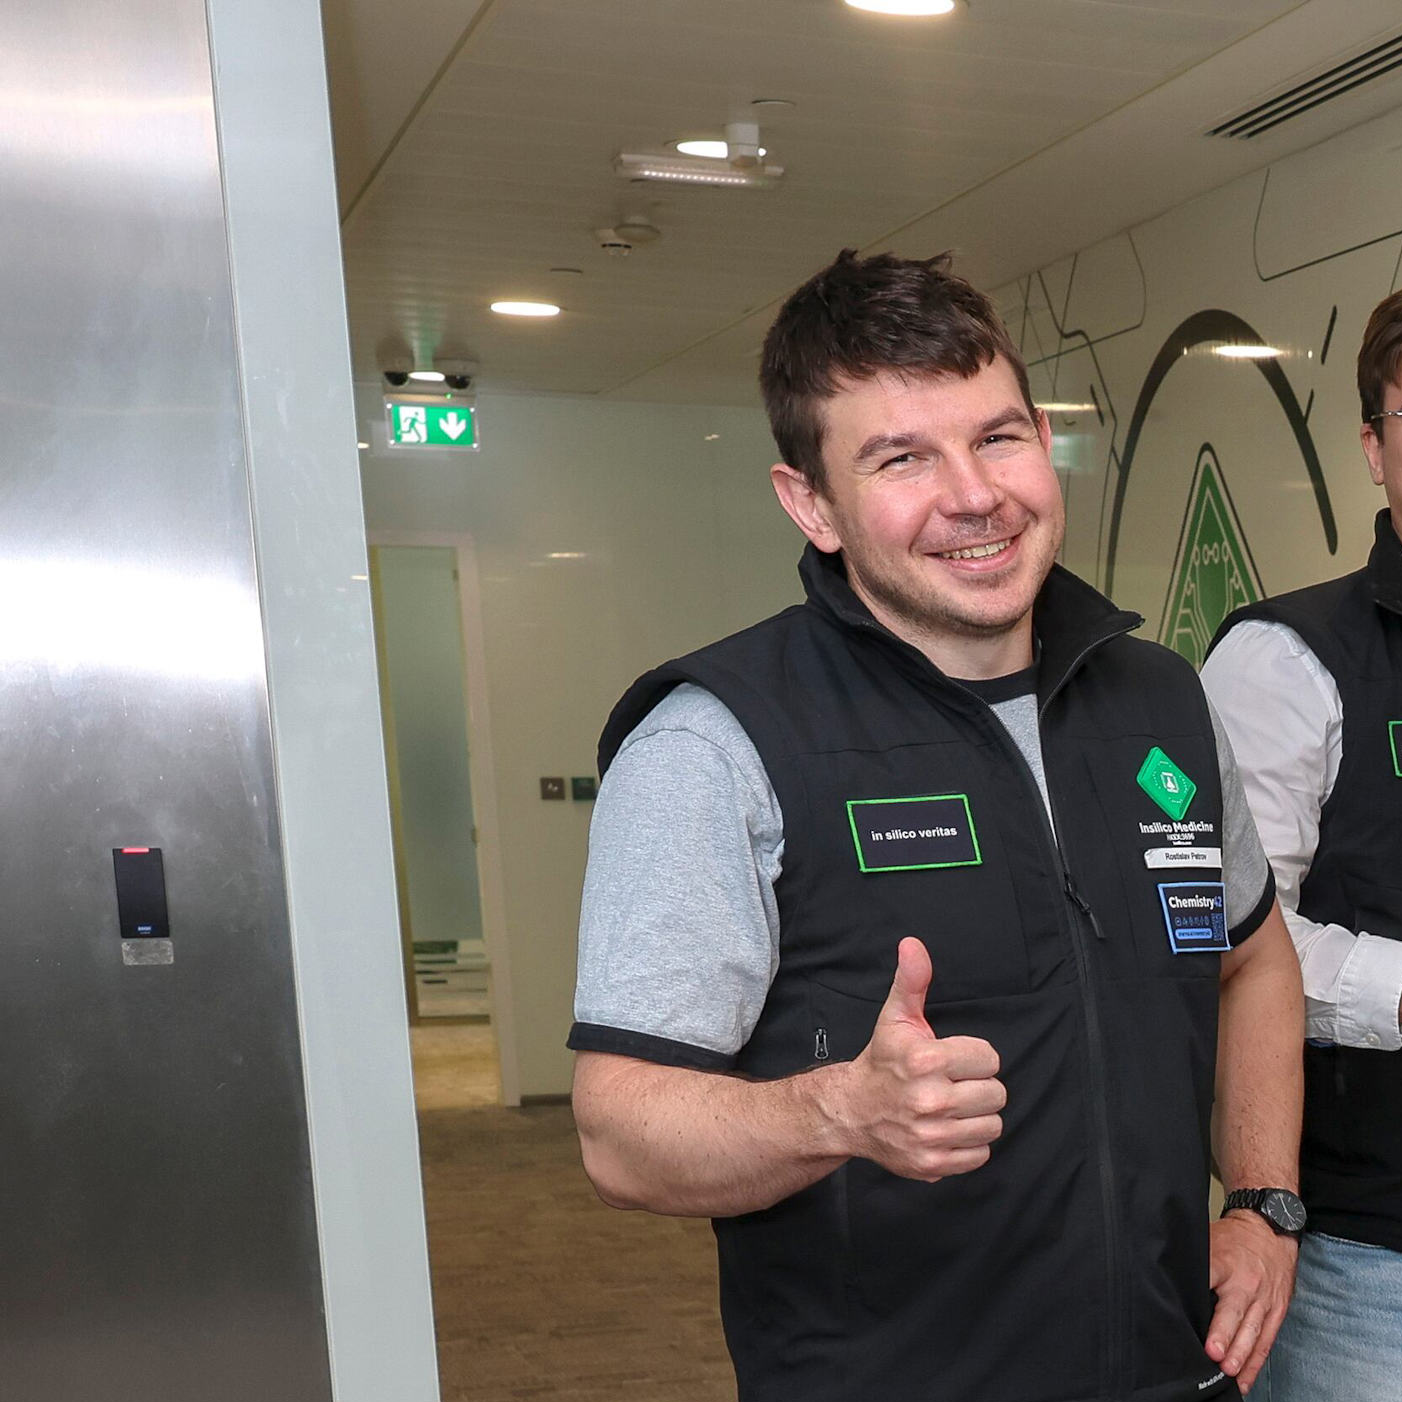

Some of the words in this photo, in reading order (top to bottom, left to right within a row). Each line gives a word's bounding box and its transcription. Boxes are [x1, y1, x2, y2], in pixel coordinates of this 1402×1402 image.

[871, 830, 883, 841] in
[885, 828, 917, 841] silico
[918, 826, 958, 838] veritas
[1139, 822, 1173, 834] Insilico
[1173, 821, 1214, 833] Medicine
[1168, 895, 1222, 910] Chemistry42
